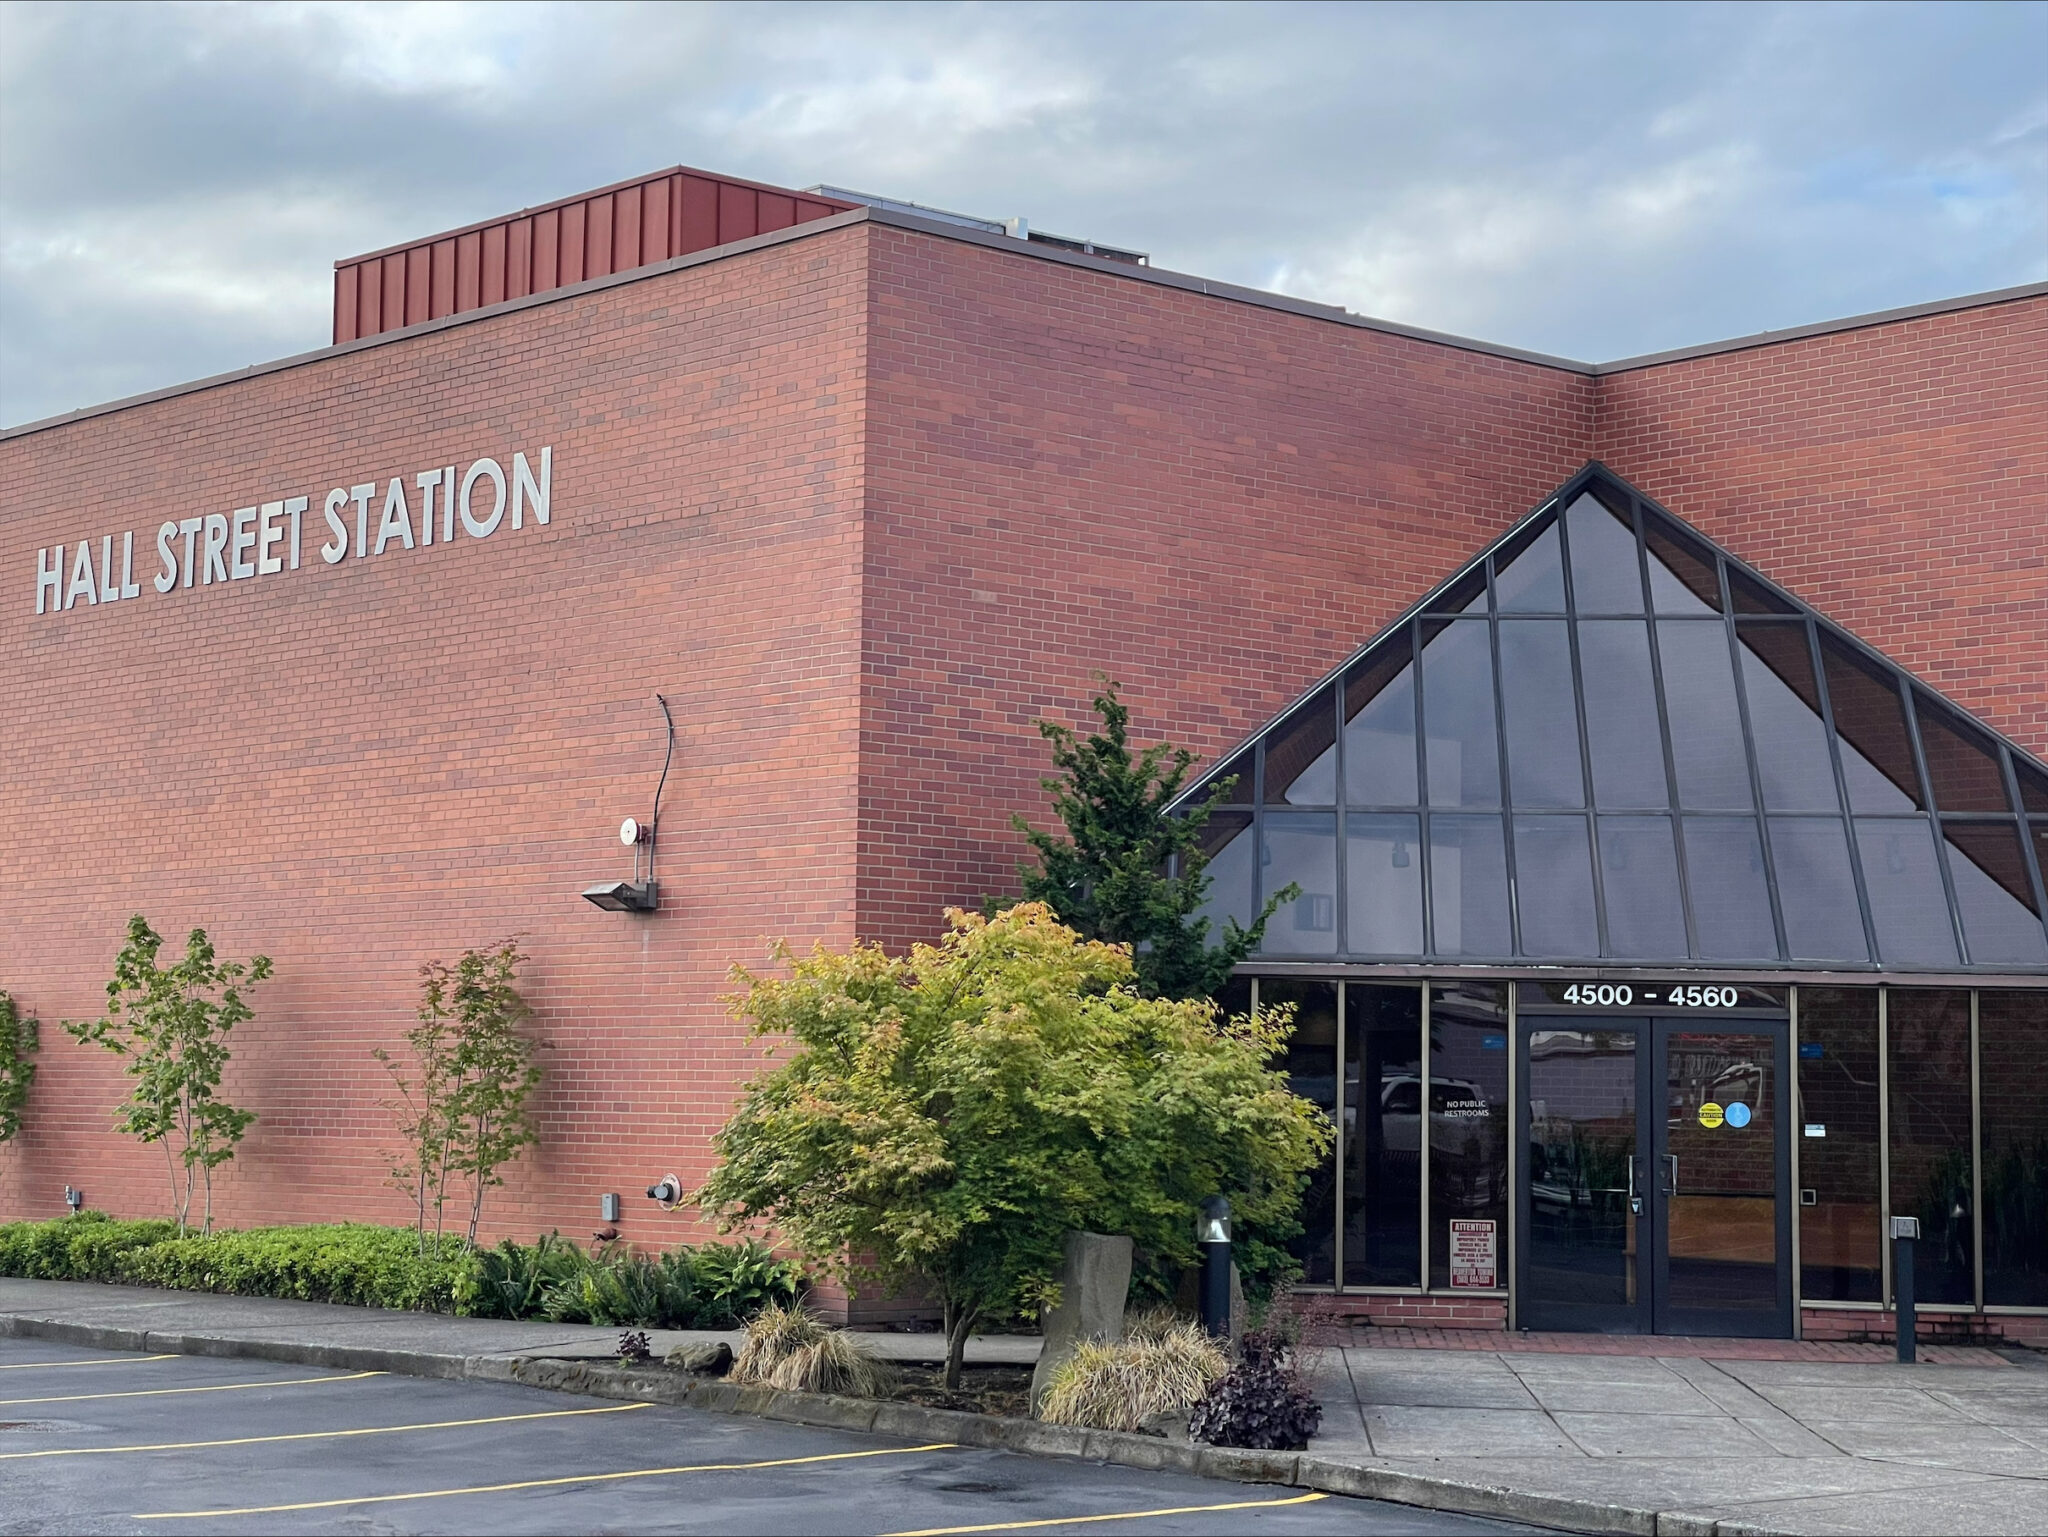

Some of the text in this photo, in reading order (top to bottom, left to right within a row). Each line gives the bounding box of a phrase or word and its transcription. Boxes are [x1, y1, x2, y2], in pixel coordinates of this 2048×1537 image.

[36, 446, 552, 614] HALL STREET STATION
[1563, 984, 1633, 1006] 4500
[1668, 986, 1738, 1007] 4560
[1446, 1100, 1486, 1108] NO PUBLIC
[1444, 1109, 1490, 1117] RESTROOMS
[1454, 1223, 1491, 1232] ATTENTION
